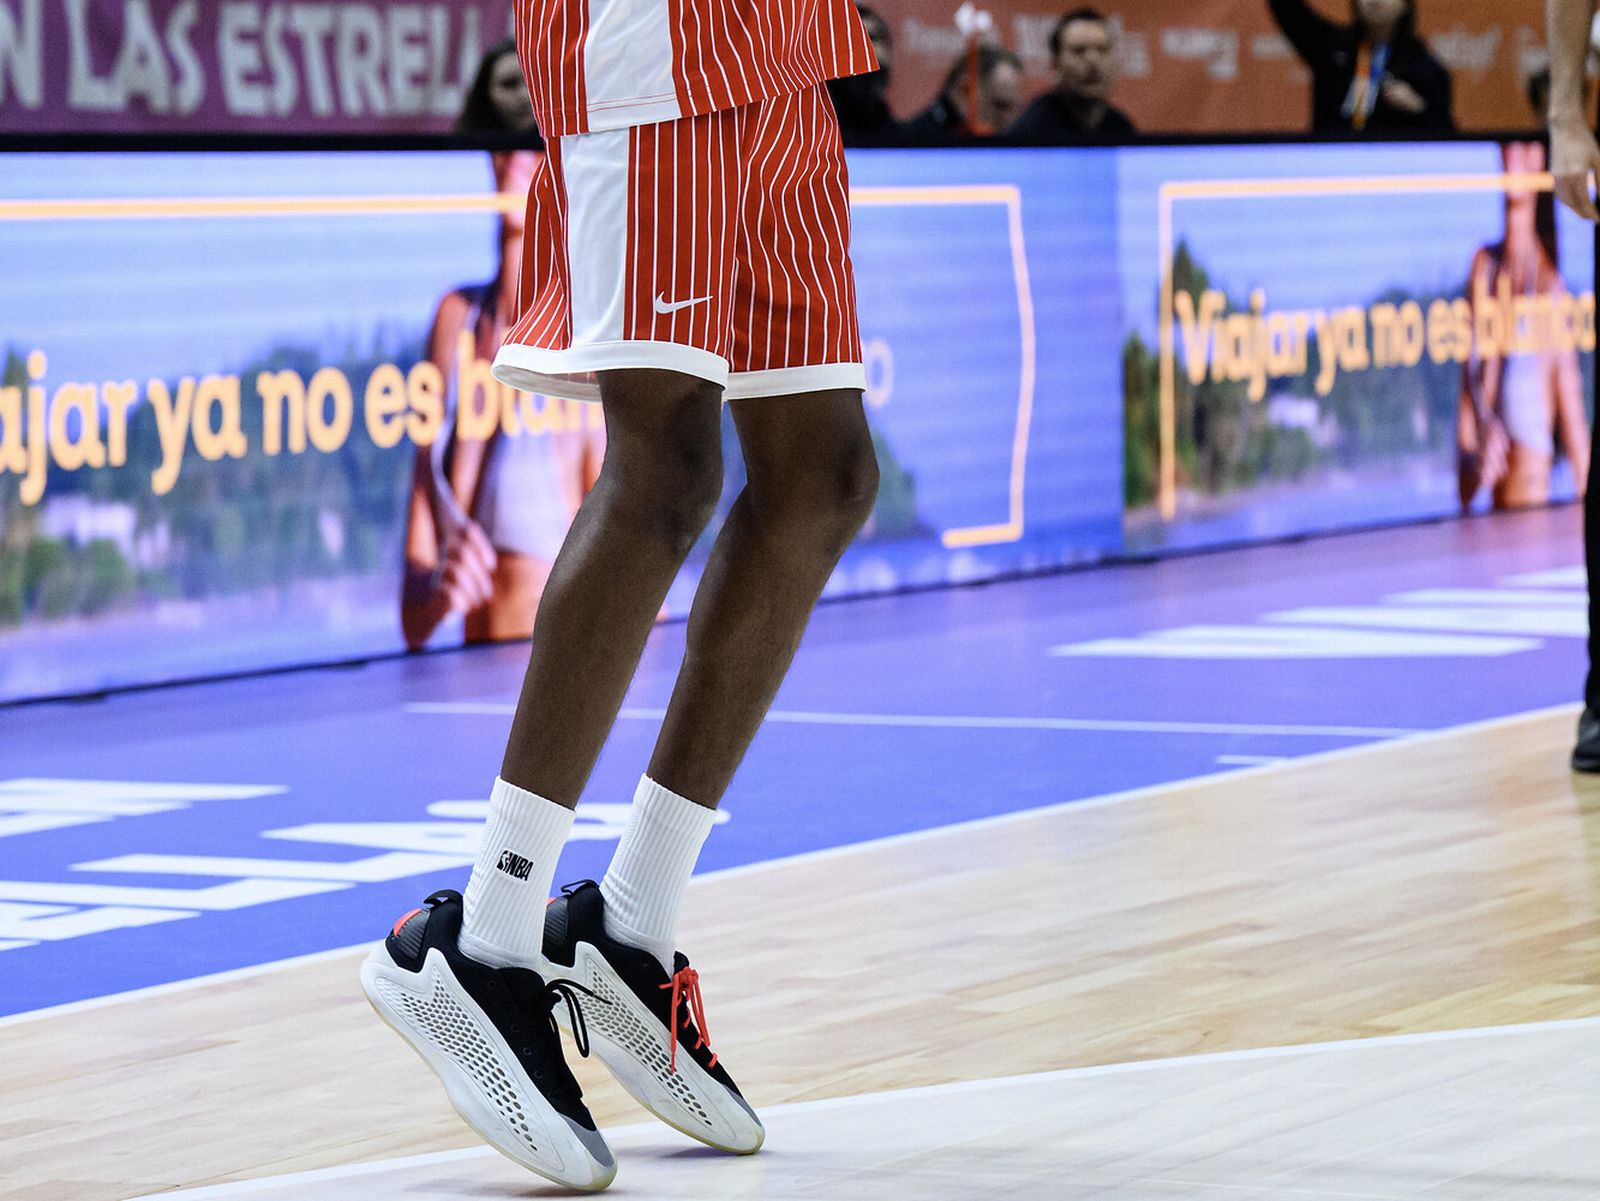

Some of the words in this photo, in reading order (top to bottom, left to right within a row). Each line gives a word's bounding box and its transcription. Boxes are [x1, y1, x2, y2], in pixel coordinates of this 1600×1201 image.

[1175, 289, 1308, 400] Viajar
[1315, 304, 1370, 396] ya
[1370, 300, 1424, 368] no
[1426, 297, 1473, 364] es
[147, 374, 248, 496] ya
[257, 367, 354, 456] no
[365, 361, 446, 448] es
[507, 852, 534, 881] NBA
